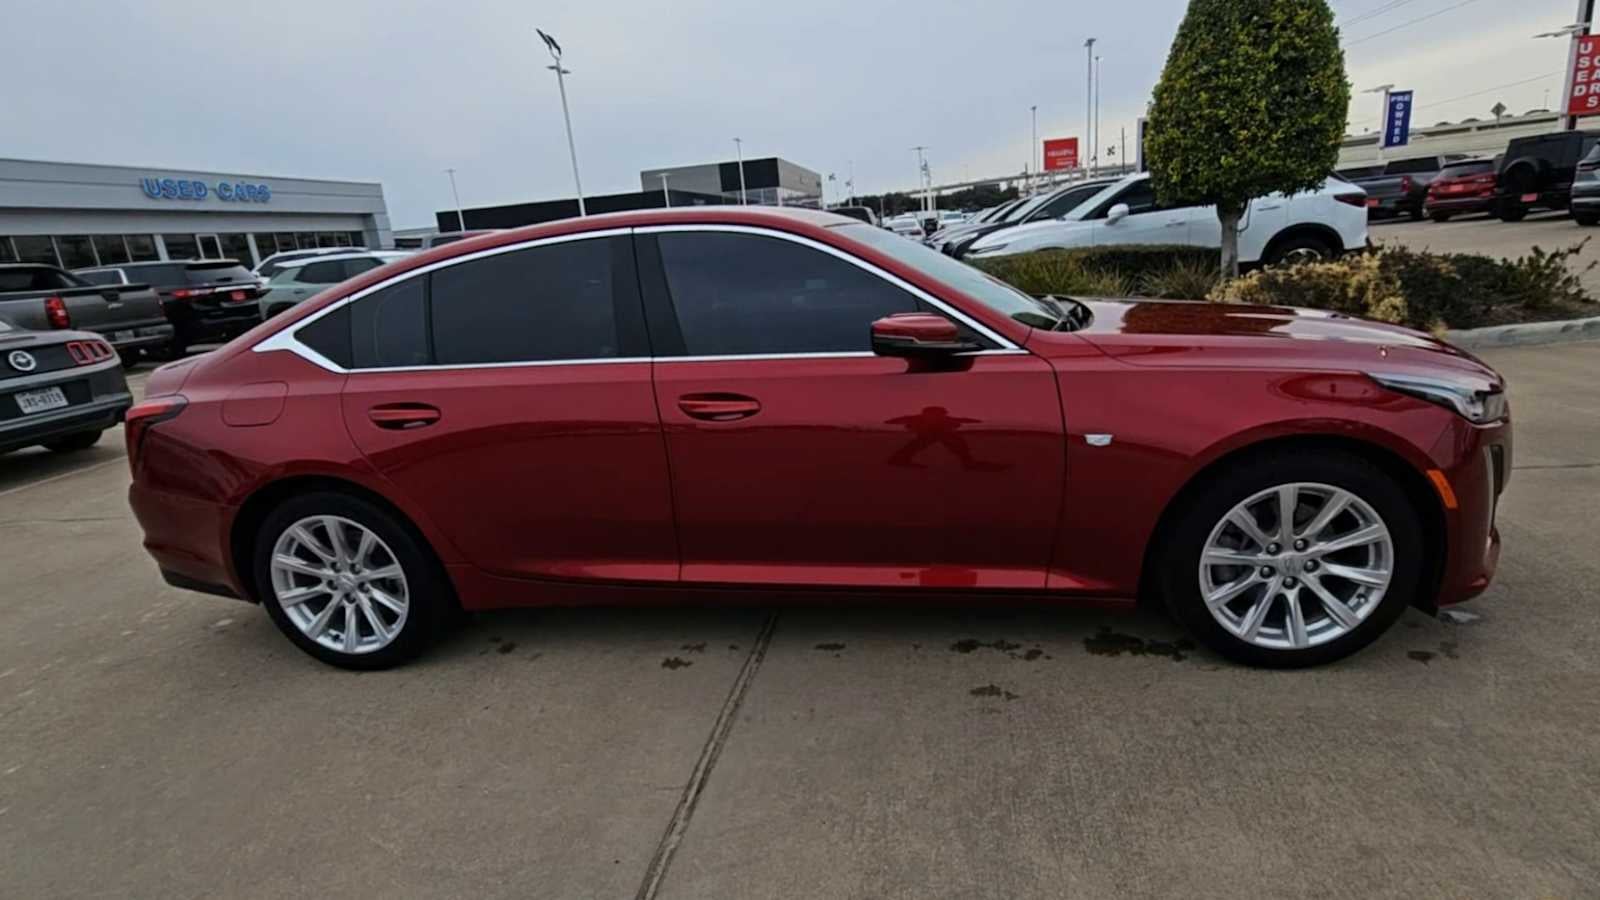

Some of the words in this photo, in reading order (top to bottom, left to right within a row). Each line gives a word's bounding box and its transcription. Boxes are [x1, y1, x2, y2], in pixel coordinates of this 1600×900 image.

[1574, 42, 1593, 97] USED
[1392, 102, 1405, 143] OWNED
[142, 177, 209, 200] USED
[216, 181, 272, 203] CARS
